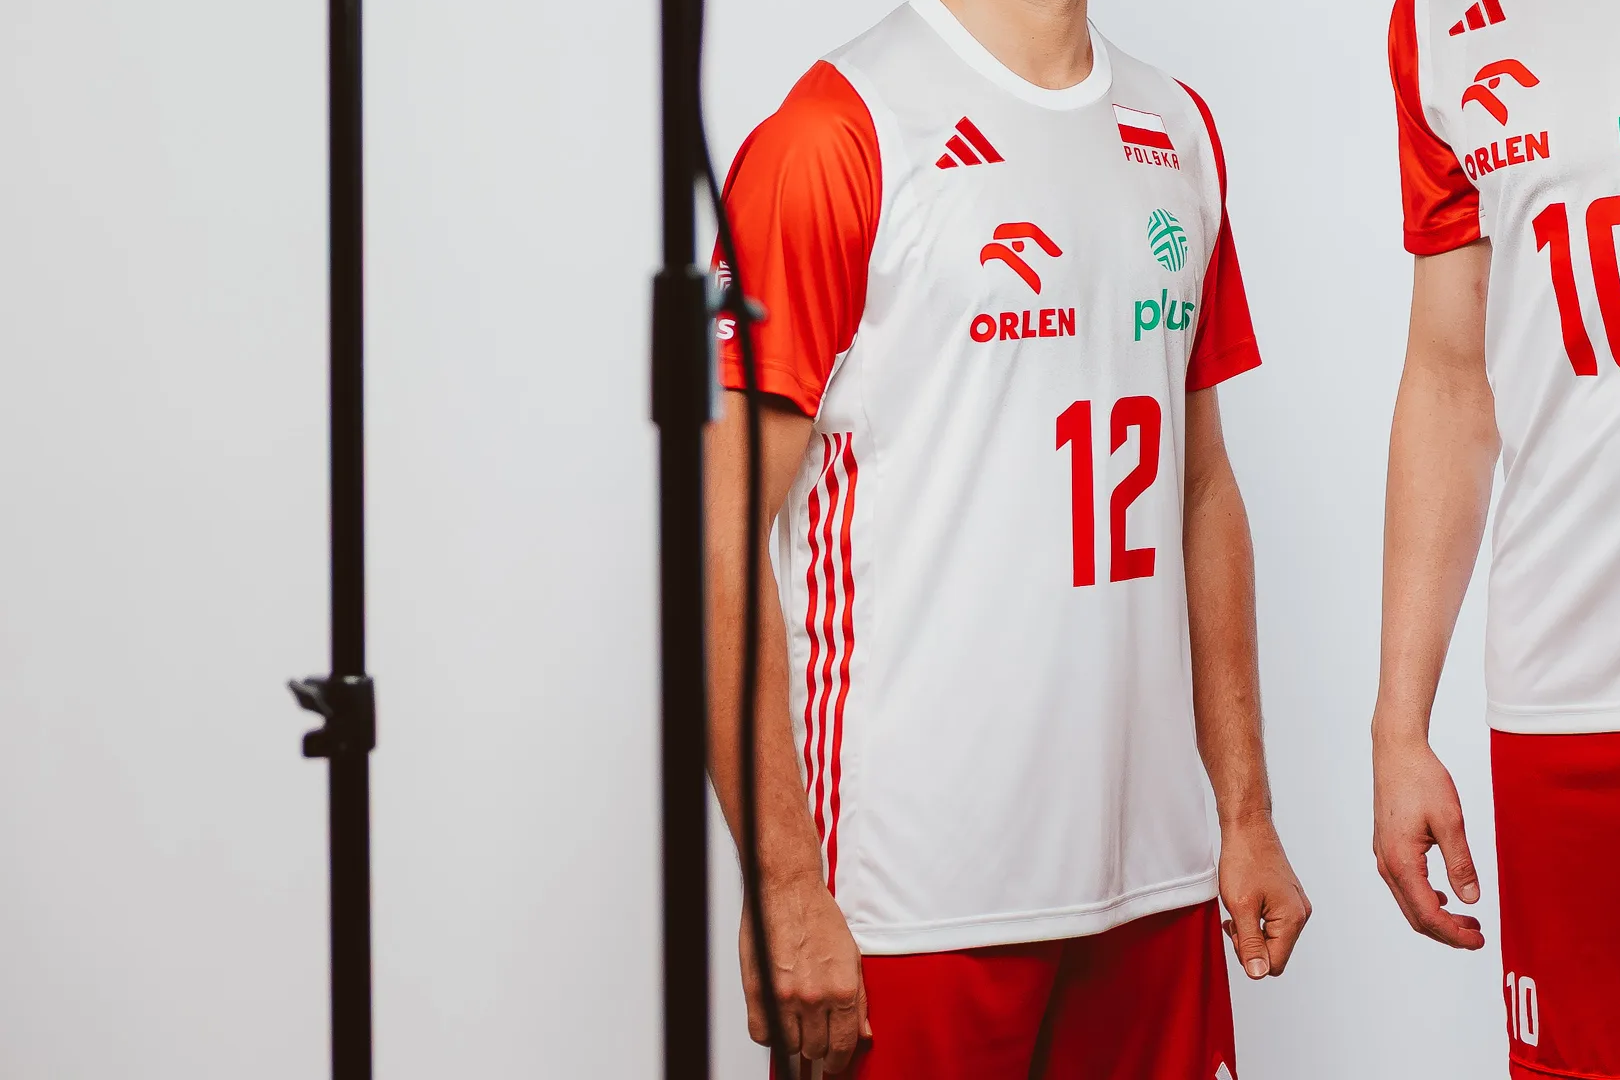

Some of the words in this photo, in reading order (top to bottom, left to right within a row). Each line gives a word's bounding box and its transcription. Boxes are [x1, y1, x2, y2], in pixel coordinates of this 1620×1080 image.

[1123, 145, 1180, 170] POLSKA
[1464, 131, 1550, 181] ORLEN
[969, 308, 1076, 343] ORLEN
[1056, 395, 1162, 587] 12
[1506, 971, 1539, 1047] 10
